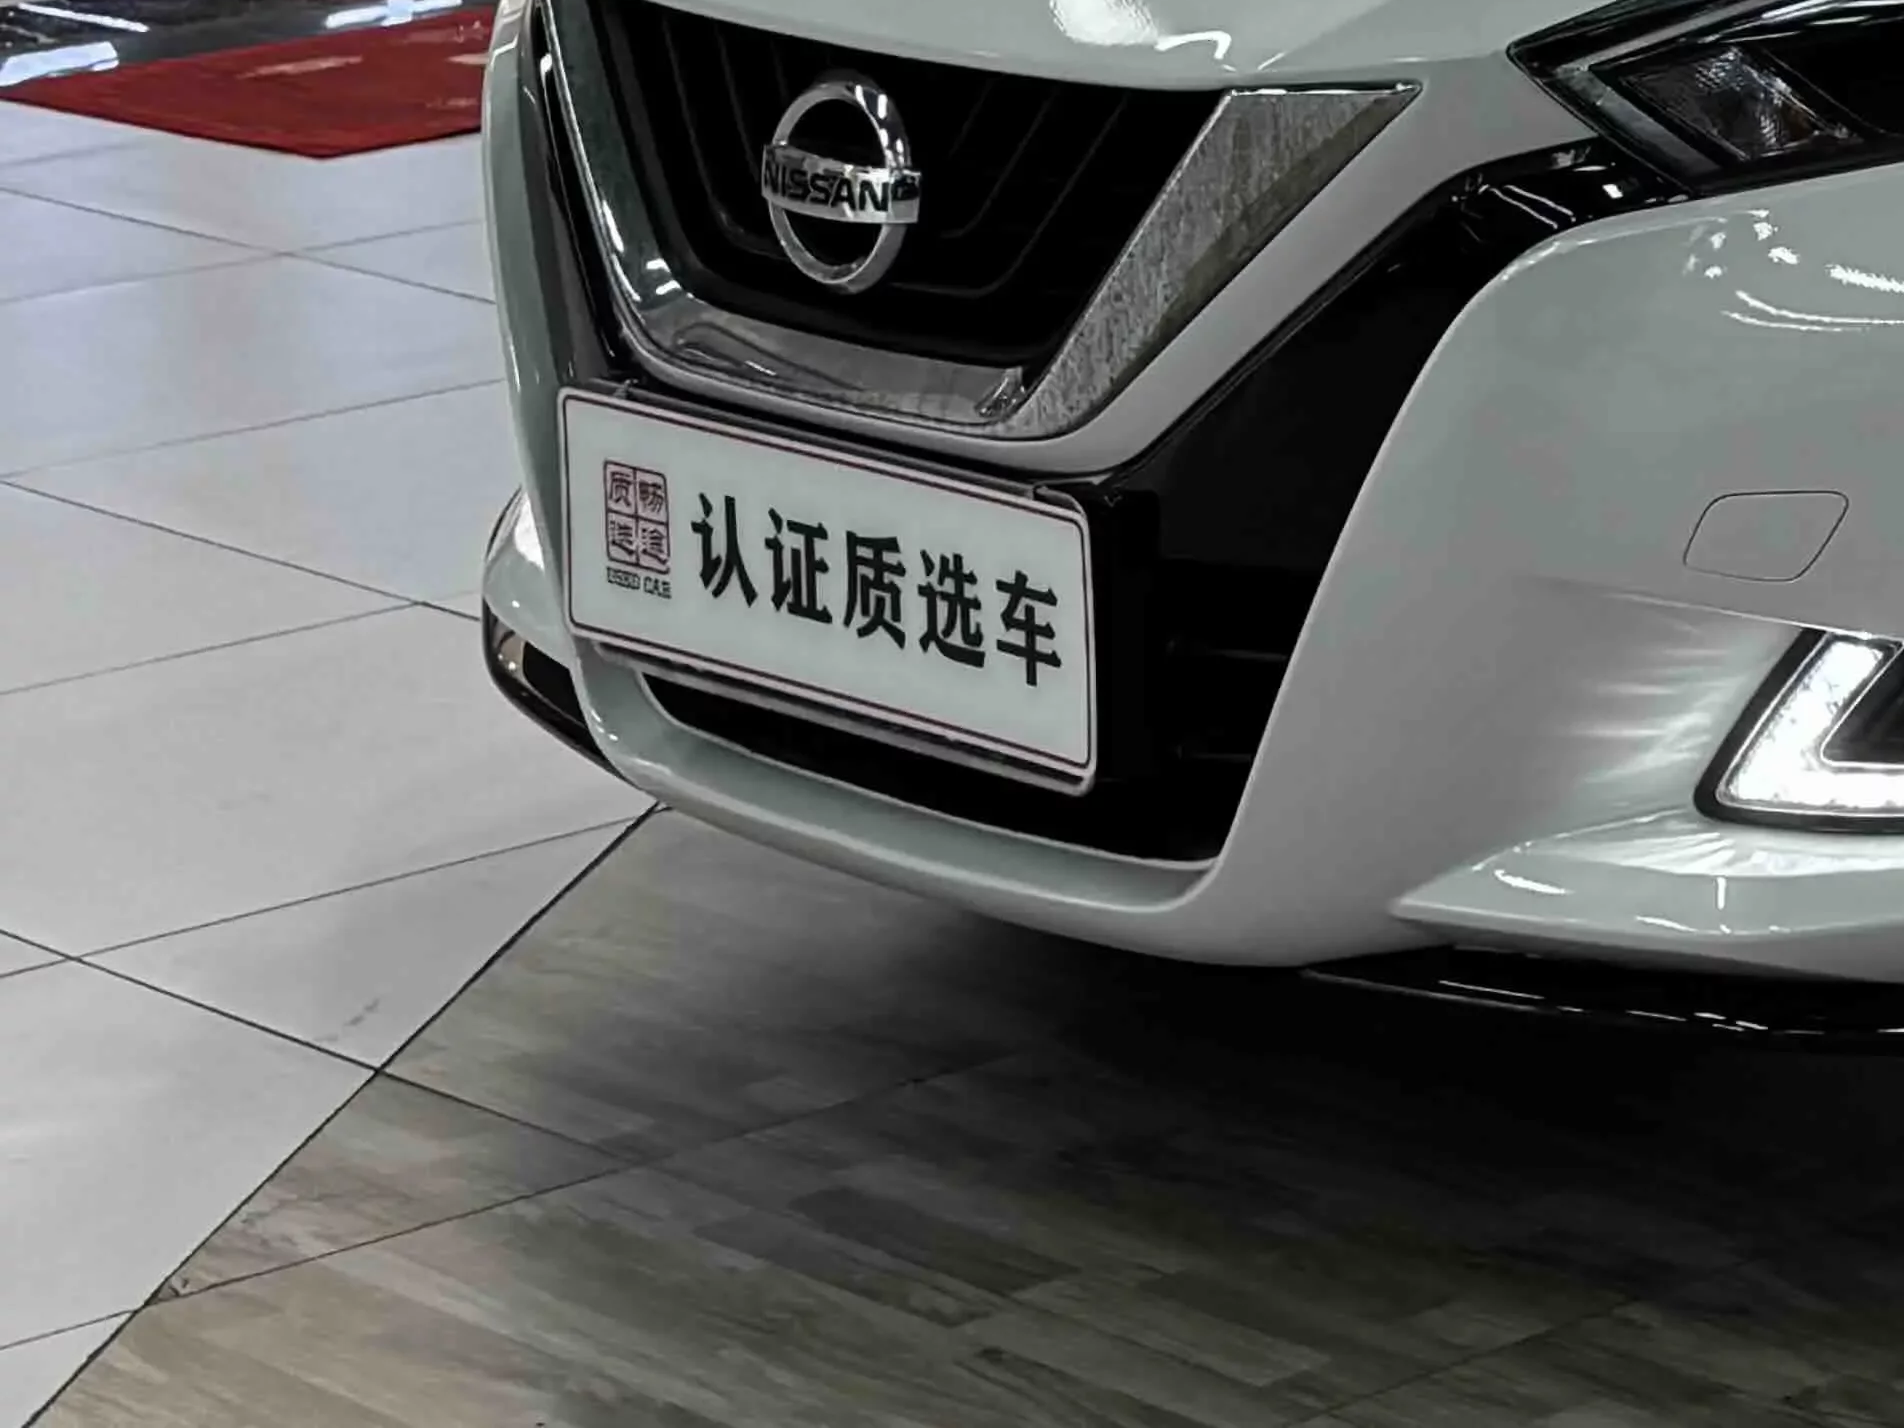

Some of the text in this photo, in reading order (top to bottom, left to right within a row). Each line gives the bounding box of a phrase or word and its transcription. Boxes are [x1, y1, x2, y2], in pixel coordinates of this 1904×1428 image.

[763, 152, 889, 212] NISSAN
[691, 491, 1062, 688] 认证质选车
